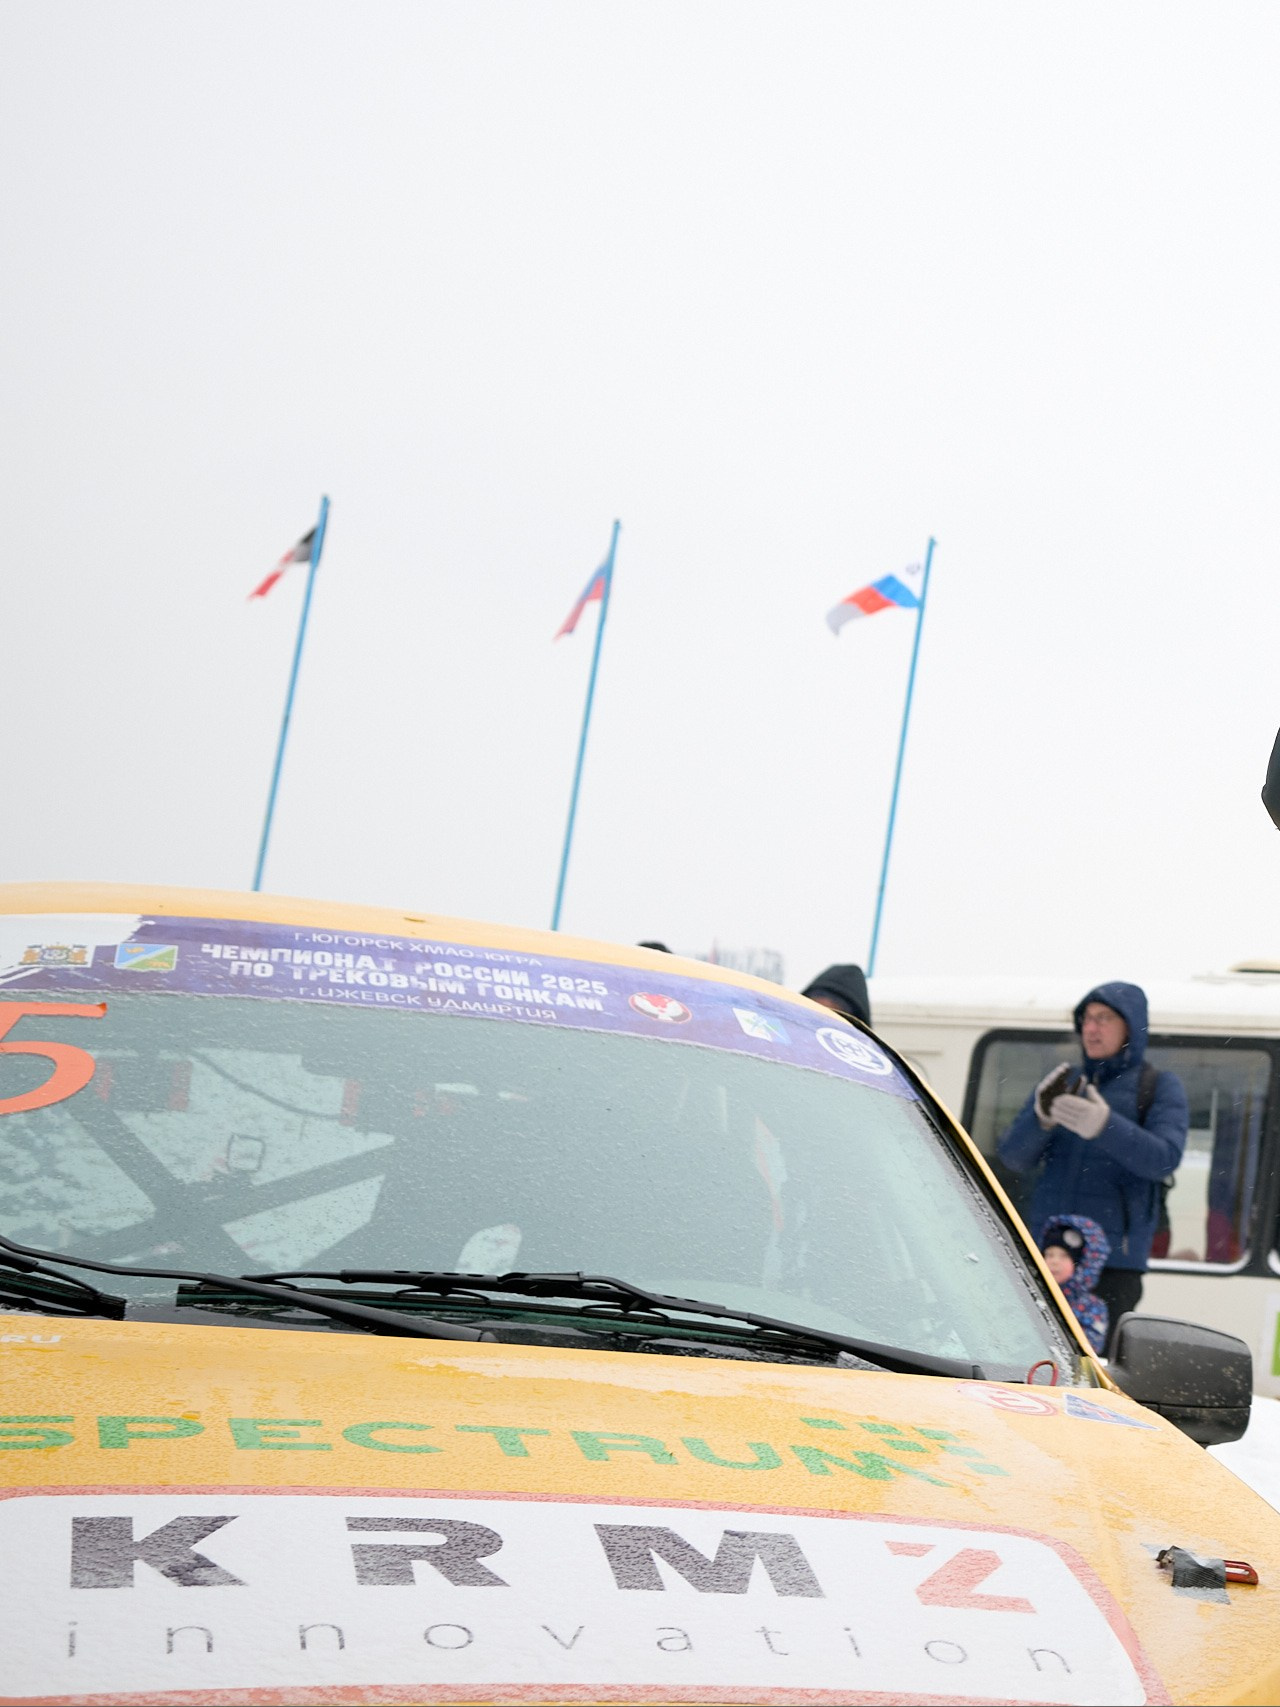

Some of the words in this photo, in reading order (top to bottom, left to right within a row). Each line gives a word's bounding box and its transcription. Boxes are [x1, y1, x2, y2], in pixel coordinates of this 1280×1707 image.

[201, 943, 398, 972] ЧЕМПИОНАТ
[414, 961, 531, 986] РОССИИ
[540, 973, 609, 995] 2025
[409, 941, 543, 967] ХМАО-ЮГРА
[229, 961, 274, 978] ПО
[288, 964, 466, 995] ТРЕКОВЫМ
[476, 982, 605, 1012] ГОНКАМ
[427, 997, 558, 1020] УДМУРТИЯ
[0, 1001, 108, 1115] 5
[67, 1620, 1072, 1675] innovation
